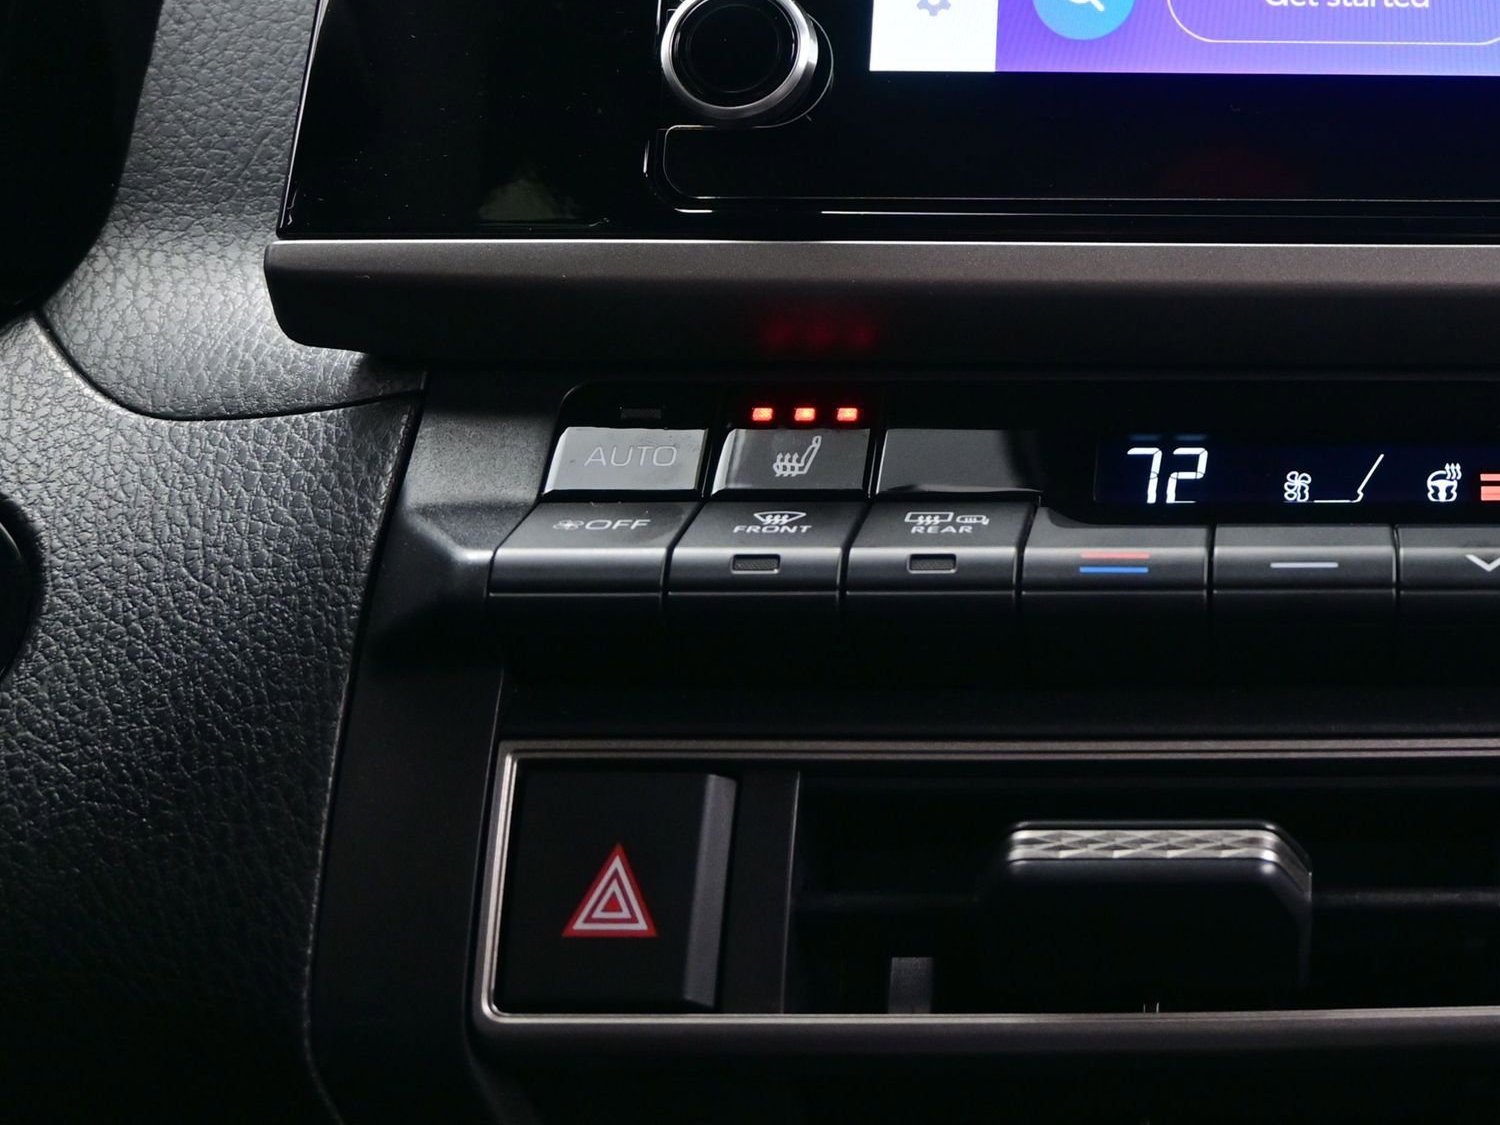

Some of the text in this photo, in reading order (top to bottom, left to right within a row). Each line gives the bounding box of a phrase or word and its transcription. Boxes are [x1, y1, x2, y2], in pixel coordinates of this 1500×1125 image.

[583, 445, 677, 467] AUTO
[1126, 447, 1209, 504] 72
[584, 518, 651, 530] OFF
[732, 524, 812, 534] FRONT
[910, 525, 974, 534] REAR
